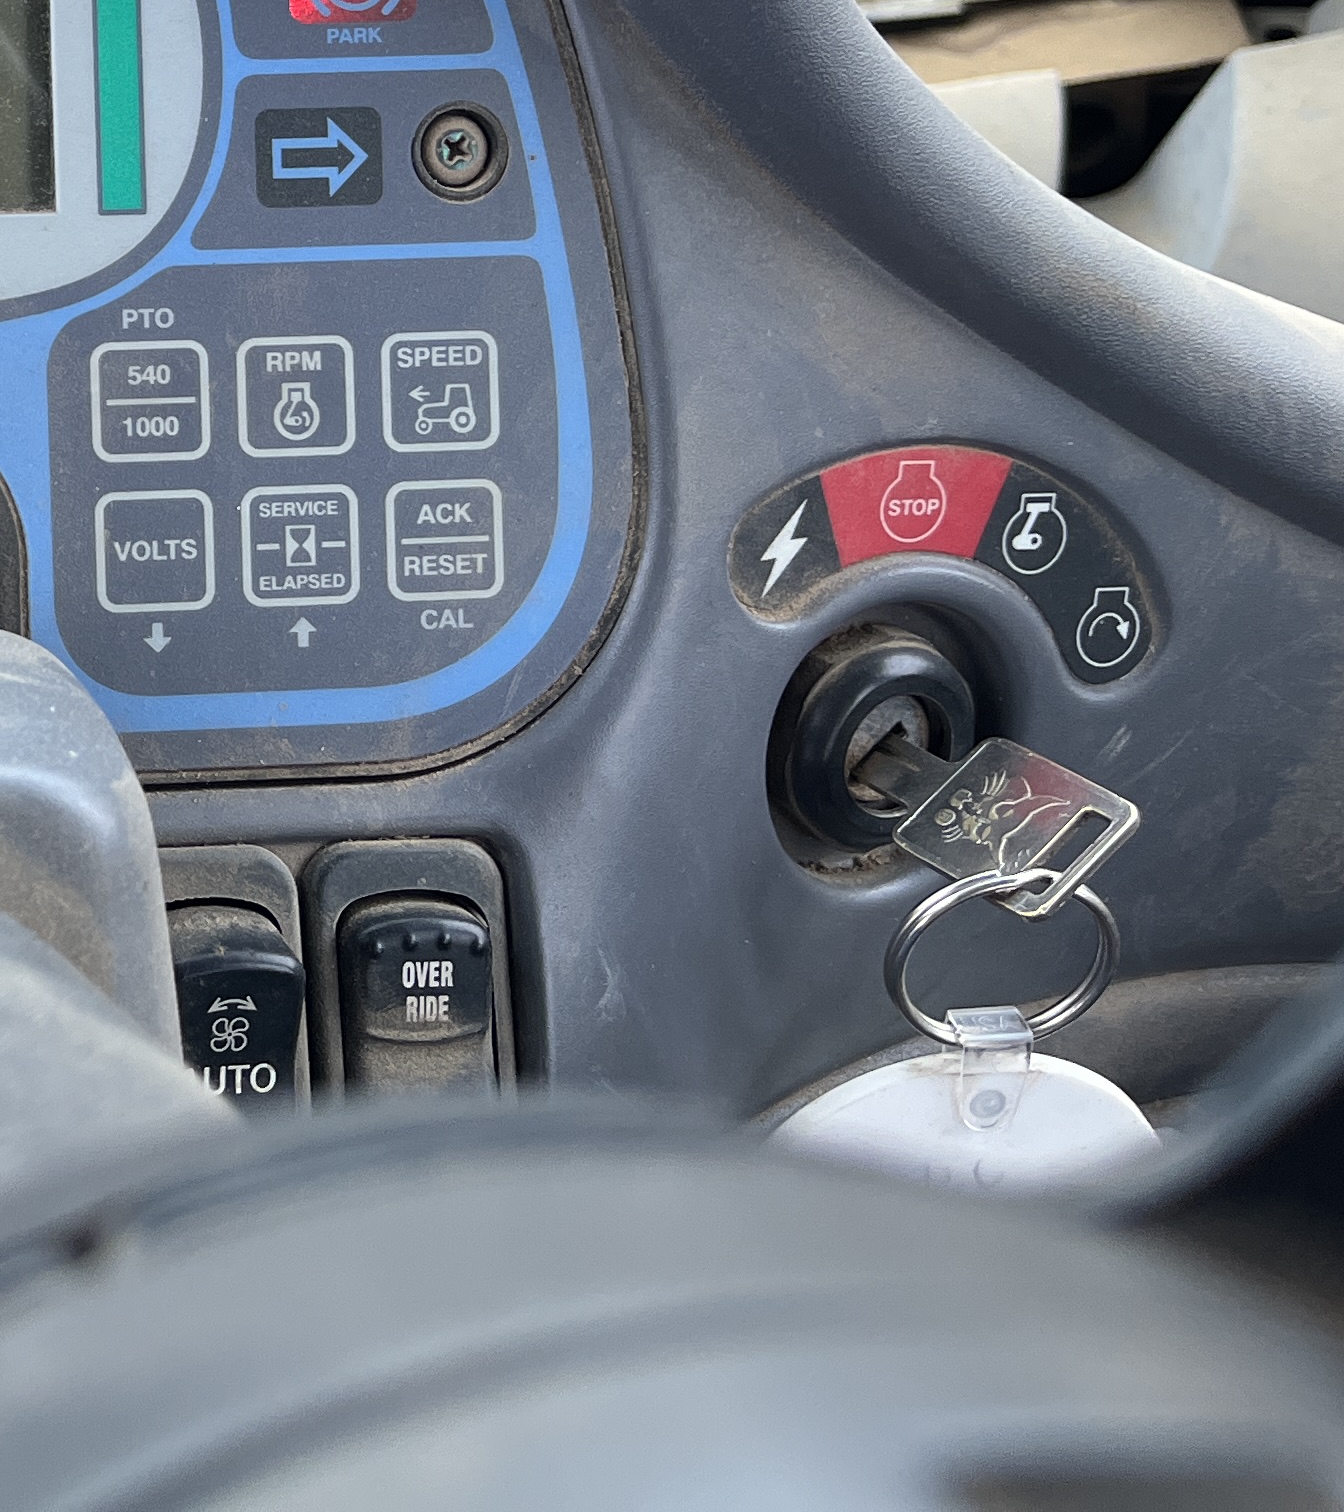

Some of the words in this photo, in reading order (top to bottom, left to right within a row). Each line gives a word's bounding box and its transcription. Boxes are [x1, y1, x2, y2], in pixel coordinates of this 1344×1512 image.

[327, 27, 382, 45] PARK
[122, 308, 175, 329] PTO
[266, 351, 322, 372] RPM
[397, 346, 483, 368] SPEED
[127, 365, 171, 386] 540
[122, 417, 179, 437] 1000
[258, 500, 339, 518] SERVICE
[416, 503, 472, 524] ACK
[888, 499, 940, 516] STOP
[114, 538, 197, 561] VOLTS
[404, 554, 488, 576] RESET
[259, 573, 346, 590] ELAPSED
[420, 609, 474, 629] CAL
[402, 960, 454, 989] OVER
[405, 995, 449, 1024] RIDE
[203, 1062, 277, 1095] UTO
